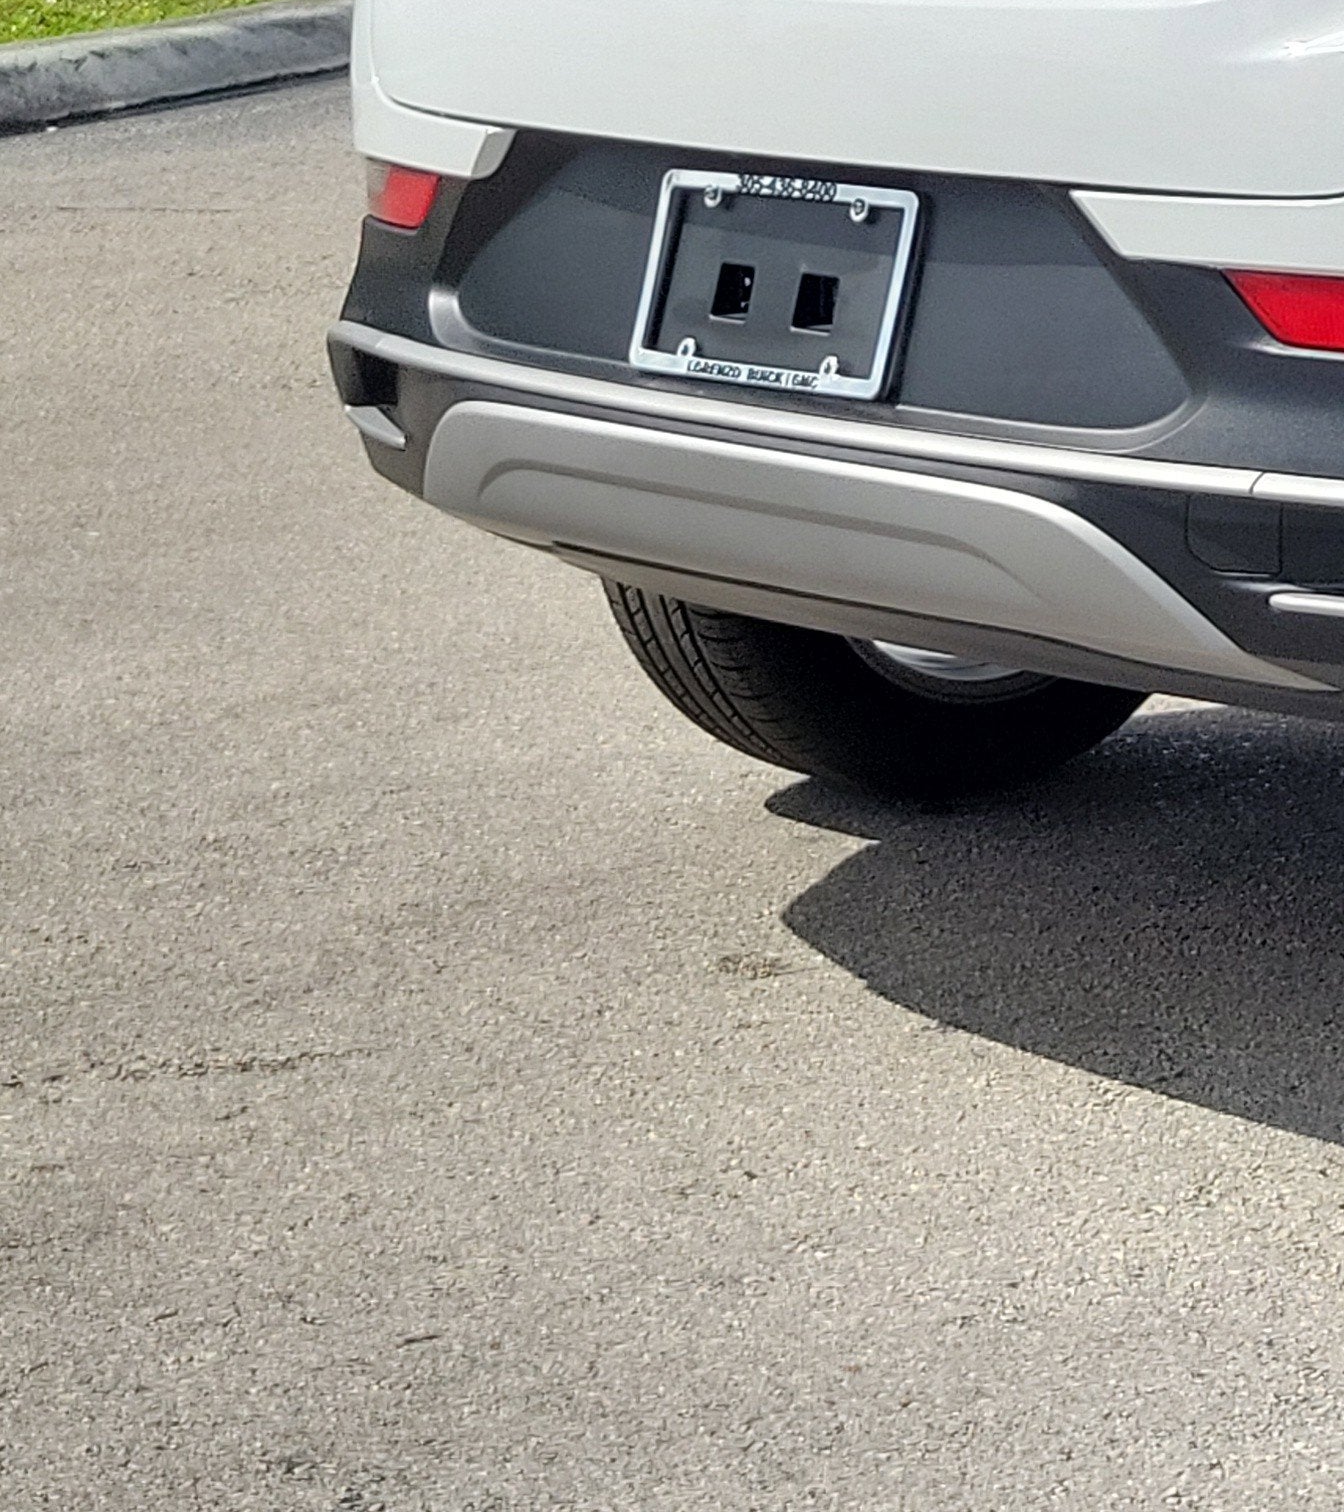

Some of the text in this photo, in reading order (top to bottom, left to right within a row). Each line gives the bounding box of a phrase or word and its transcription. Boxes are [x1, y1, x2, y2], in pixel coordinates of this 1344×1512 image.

[737, 172, 837, 201] 305-436-8400
[687, 360, 742, 379] LORENZO
[747, 368, 783, 384] BUICK
[792, 374, 819, 389] GMC
